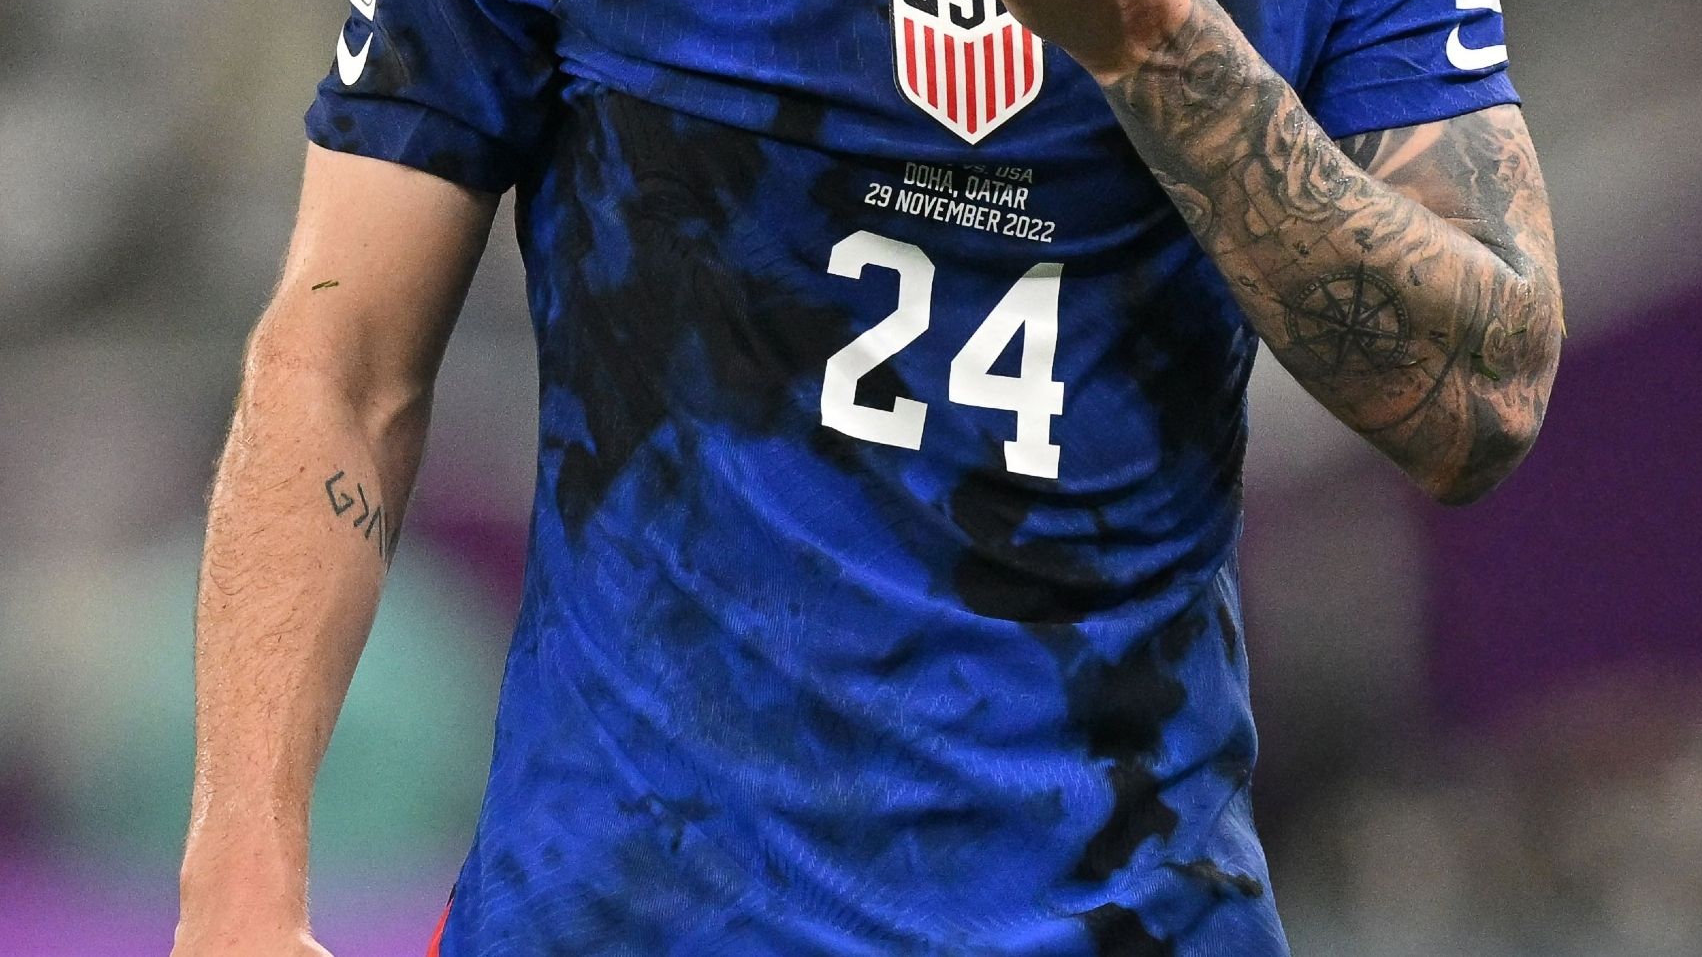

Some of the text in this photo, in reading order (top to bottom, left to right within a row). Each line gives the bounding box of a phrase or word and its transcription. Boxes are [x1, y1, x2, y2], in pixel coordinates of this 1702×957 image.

[904, 161, 1029, 210] DOHA, QATAR
[995, 165, 1033, 184] USA
[864, 183, 1056, 243] 29 NOVEMBER 2022
[820, 230, 1065, 479] 24
